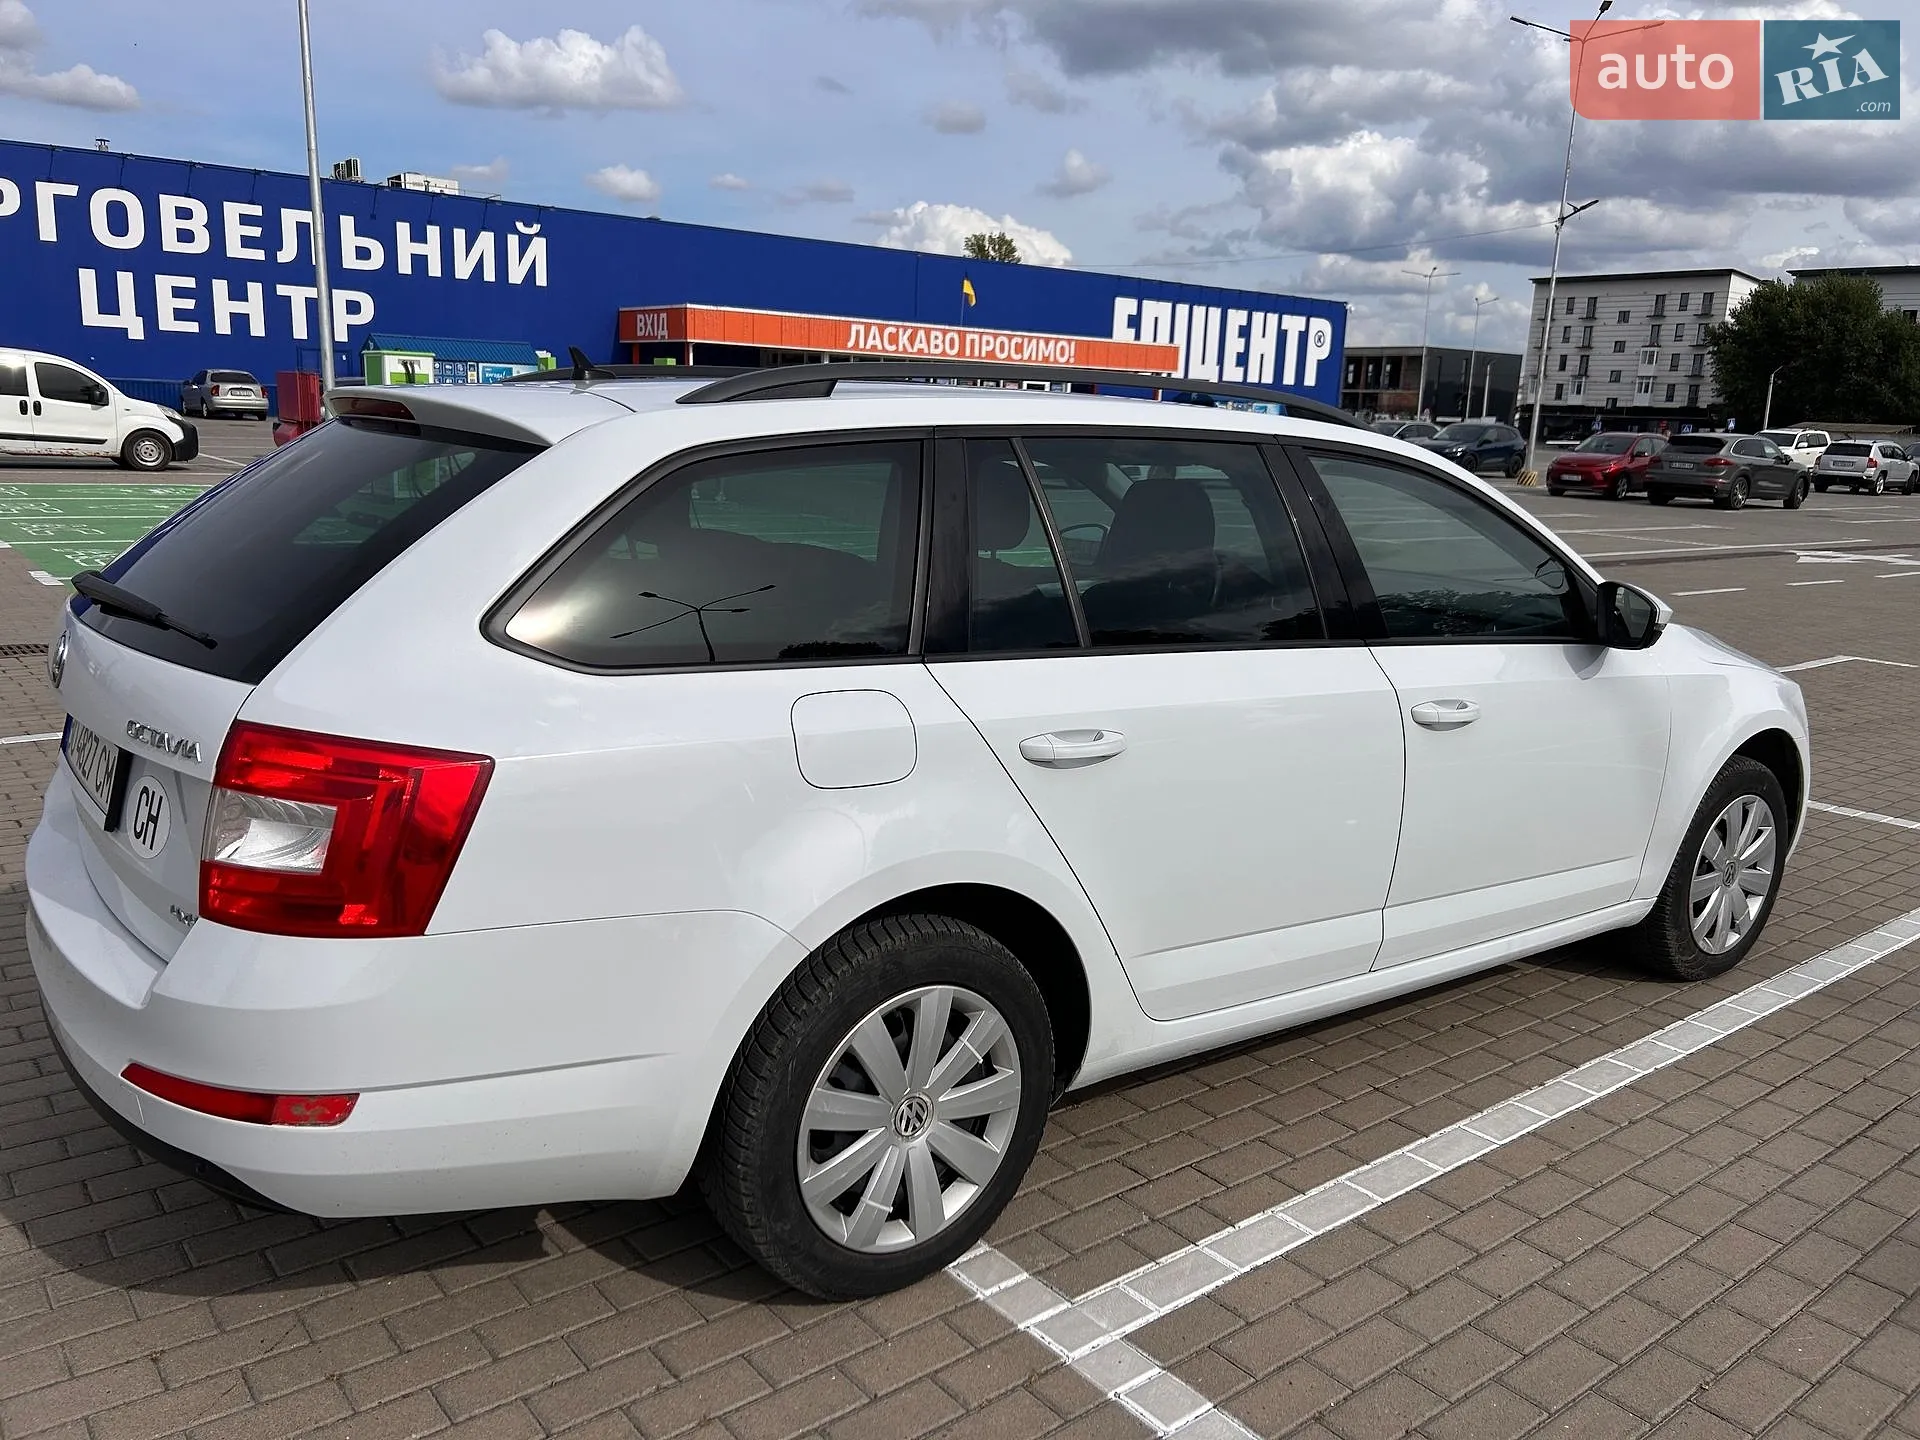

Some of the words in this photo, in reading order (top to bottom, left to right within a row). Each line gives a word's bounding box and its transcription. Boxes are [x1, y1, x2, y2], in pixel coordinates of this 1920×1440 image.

[78, 267, 375, 343] ЦЕНТР
[636, 312, 668, 341] ВХІД
[848, 324, 961, 356] ЛАСКАВО
[964, 333, 1076, 364] ПРОСИМО!
[127, 719, 202, 762] OCTAVIA
[133, 785, 164, 851] CH
